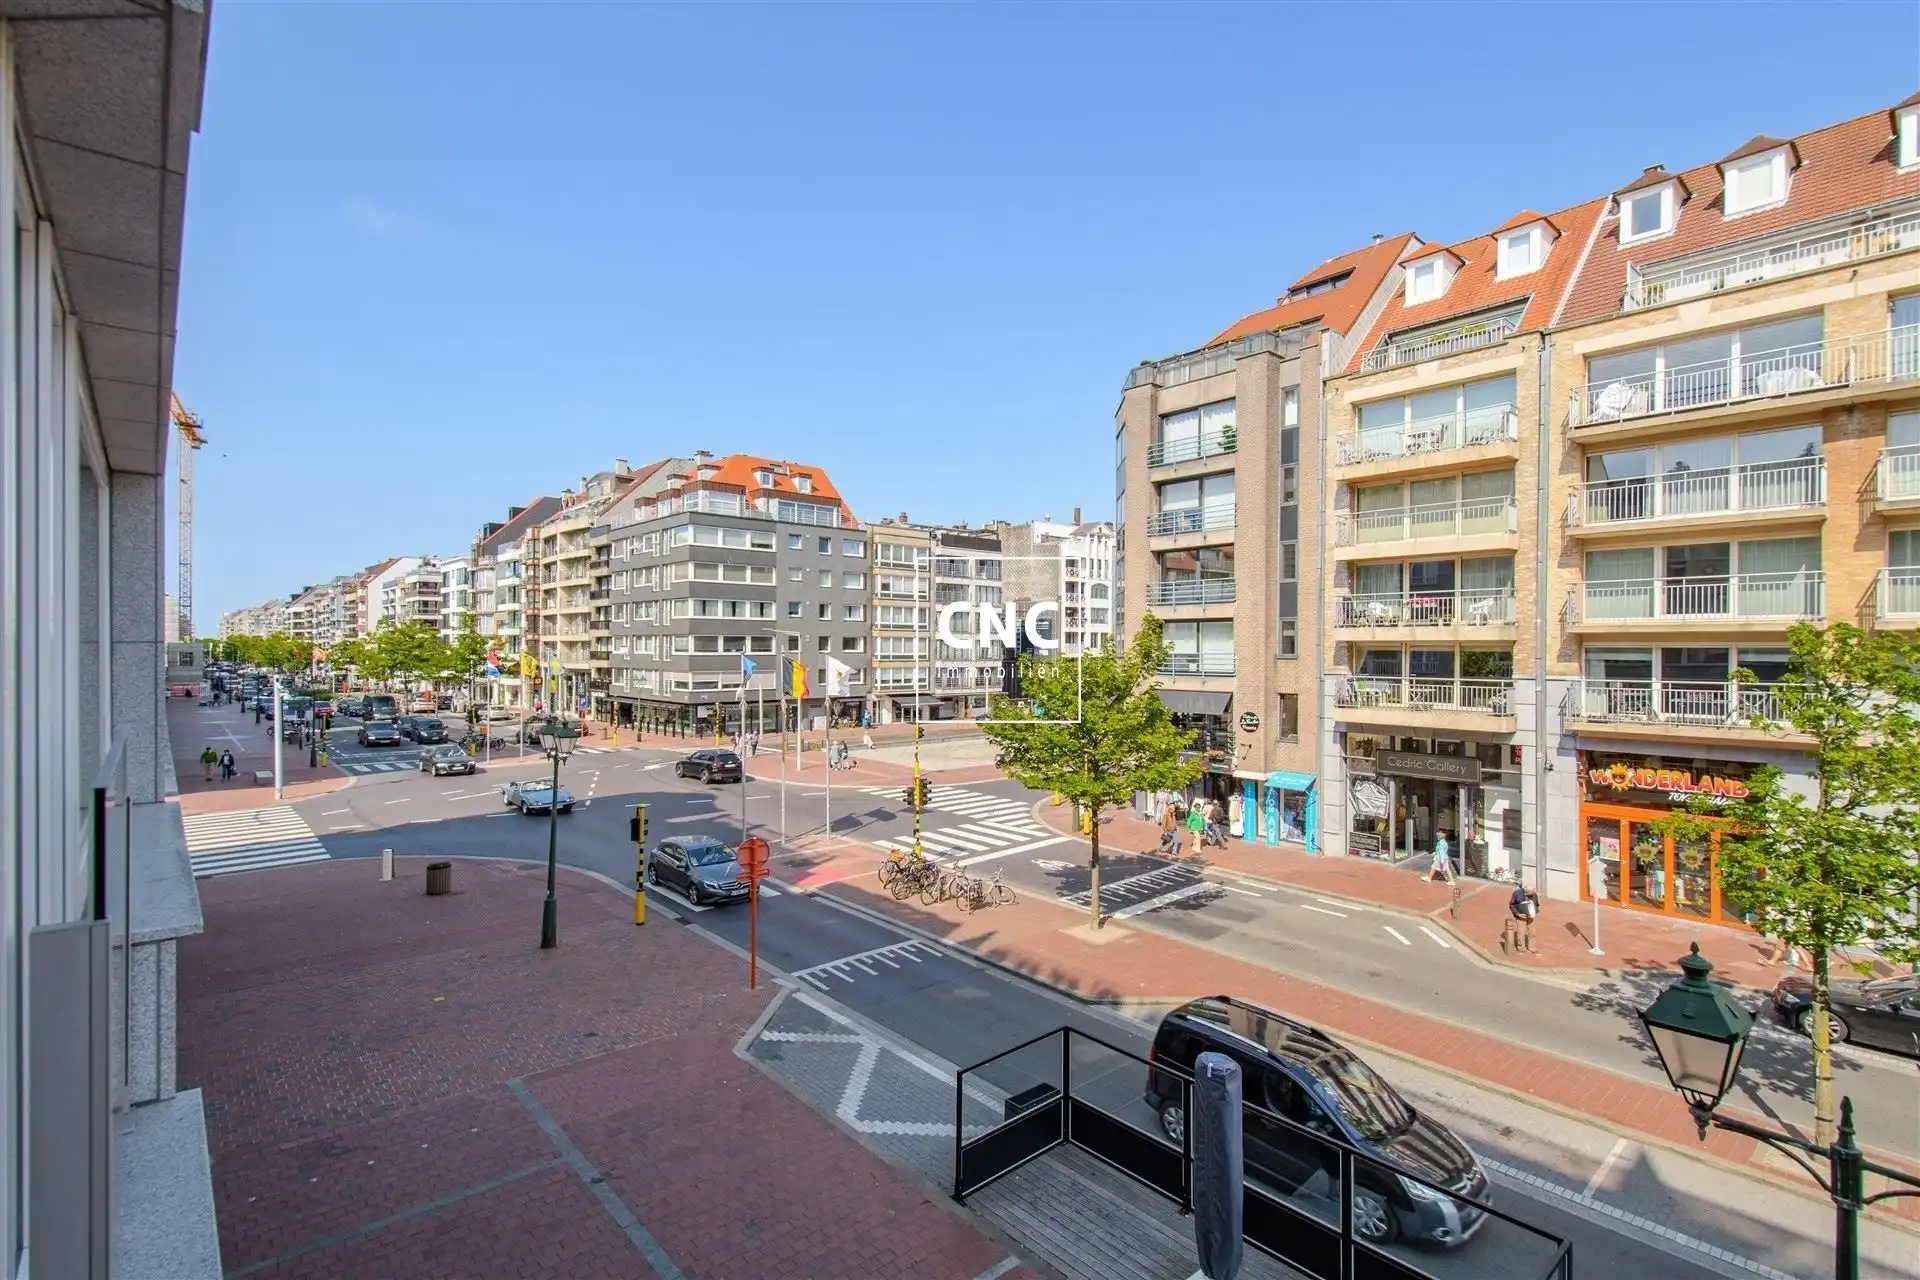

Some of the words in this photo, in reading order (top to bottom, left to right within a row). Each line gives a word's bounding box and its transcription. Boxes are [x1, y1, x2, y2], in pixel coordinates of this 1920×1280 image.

[1387, 756, 1424, 769] Cedric
[1426, 759, 1467, 776] Gallery
[1589, 763, 1749, 798] WONDERLAND
